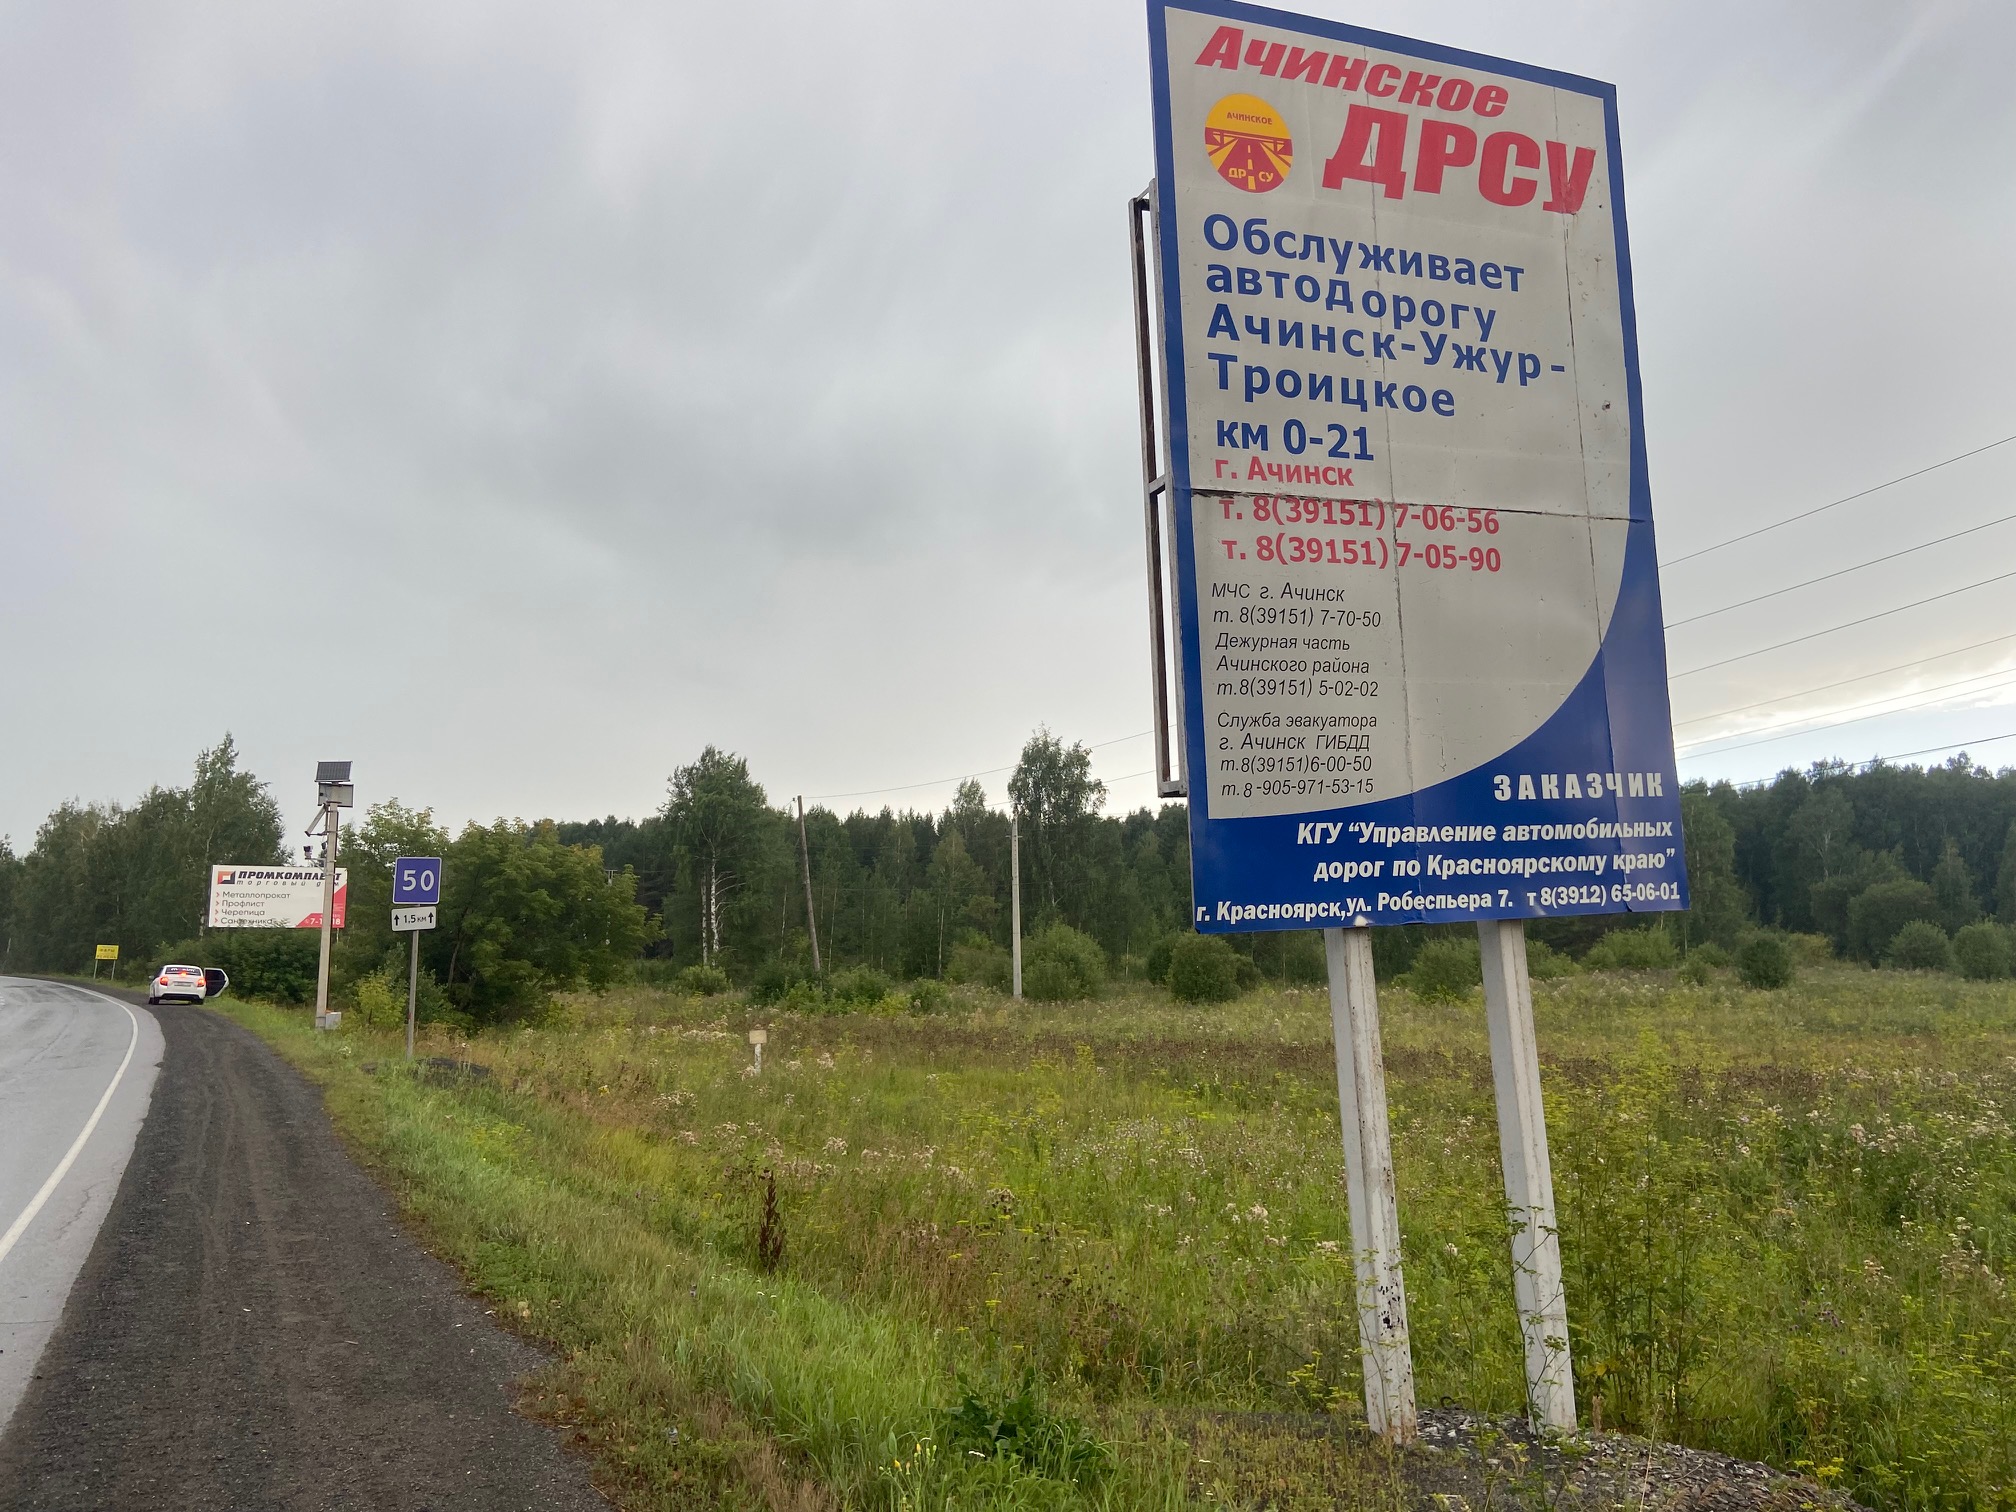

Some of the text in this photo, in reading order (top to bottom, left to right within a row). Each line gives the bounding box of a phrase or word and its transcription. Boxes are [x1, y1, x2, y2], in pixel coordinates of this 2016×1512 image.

[1194, 26, 1509, 118] Ачинское
[1227, 112, 1273, 125] АЧИНСКОЕ
[1322, 104, 1596, 215] ДРСУ
[1203, 213, 1525, 292] Обслуживает
[1206, 264, 1496, 342] автодорогу
[1207, 352, 1455, 417] Троицкое
[1216, 418, 1374, 461] км 0-21
[1215, 456, 1354, 486] г. Ачинск
[1219, 494, 1500, 534] т. 8(39151) 7-06-56
[1222, 533, 1501, 572] т. 8(39151) 7-05-90
[1211, 582, 1345, 602] МЧС г. Ачинск
[1213, 604, 1381, 627] т. 8(39151) 7-70-50
[1215, 633, 1350, 651] Дежурная часть
[1216, 655, 1370, 675] Ачинского района
[1319, 680, 1379, 697] 5-02-02
[1217, 712, 1377, 731] Служба эвакуатора
[1219, 733, 1370, 752] г. Ачинск ГИБДД
[1493, 772, 1663, 801] ЗАКАЗЧИК
[1297, 817, 1672, 847] КГУ “Управление автомобильных
[237, 871, 342, 881] ПРОМКОМПЛЕТ
[402, 869, 435, 892] 50
[1313, 860, 1385, 882] дорог
[1392, 858, 1420, 877] по
[1427, 854, 1607, 880] Красноярскому
[221, 900, 265, 908] Профлист
[222, 891, 291, 900] Металлопрокат
[1196, 906, 1210, 922] г.
[1377, 890, 1492, 912] Робеспьера
[1497, 889, 1513, 908] 7.
[1527, 892, 1536, 906] т
[1540, 884, 1607, 909] 8(3912)
[1611, 881, 1680, 902] 65-06-01
[221, 909, 266, 917] Черепица
